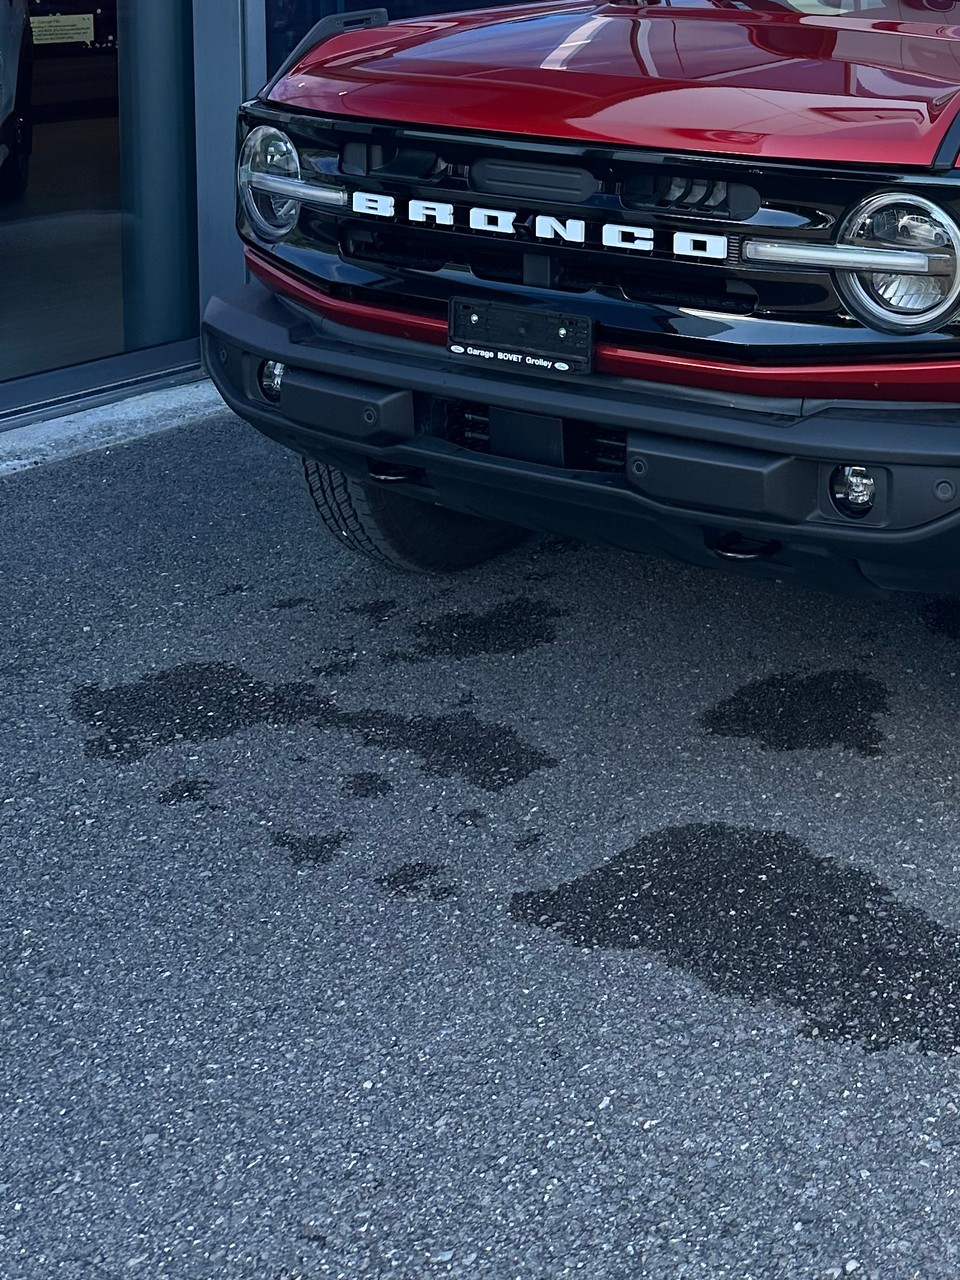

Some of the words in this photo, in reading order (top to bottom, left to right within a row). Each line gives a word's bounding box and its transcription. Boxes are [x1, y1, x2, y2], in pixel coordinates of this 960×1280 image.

[352, 191, 728, 259] BRONCO
[466, 346, 494, 358] Garage
[497, 351, 523, 363] BOVET
[525, 356, 553, 369] Grolley
